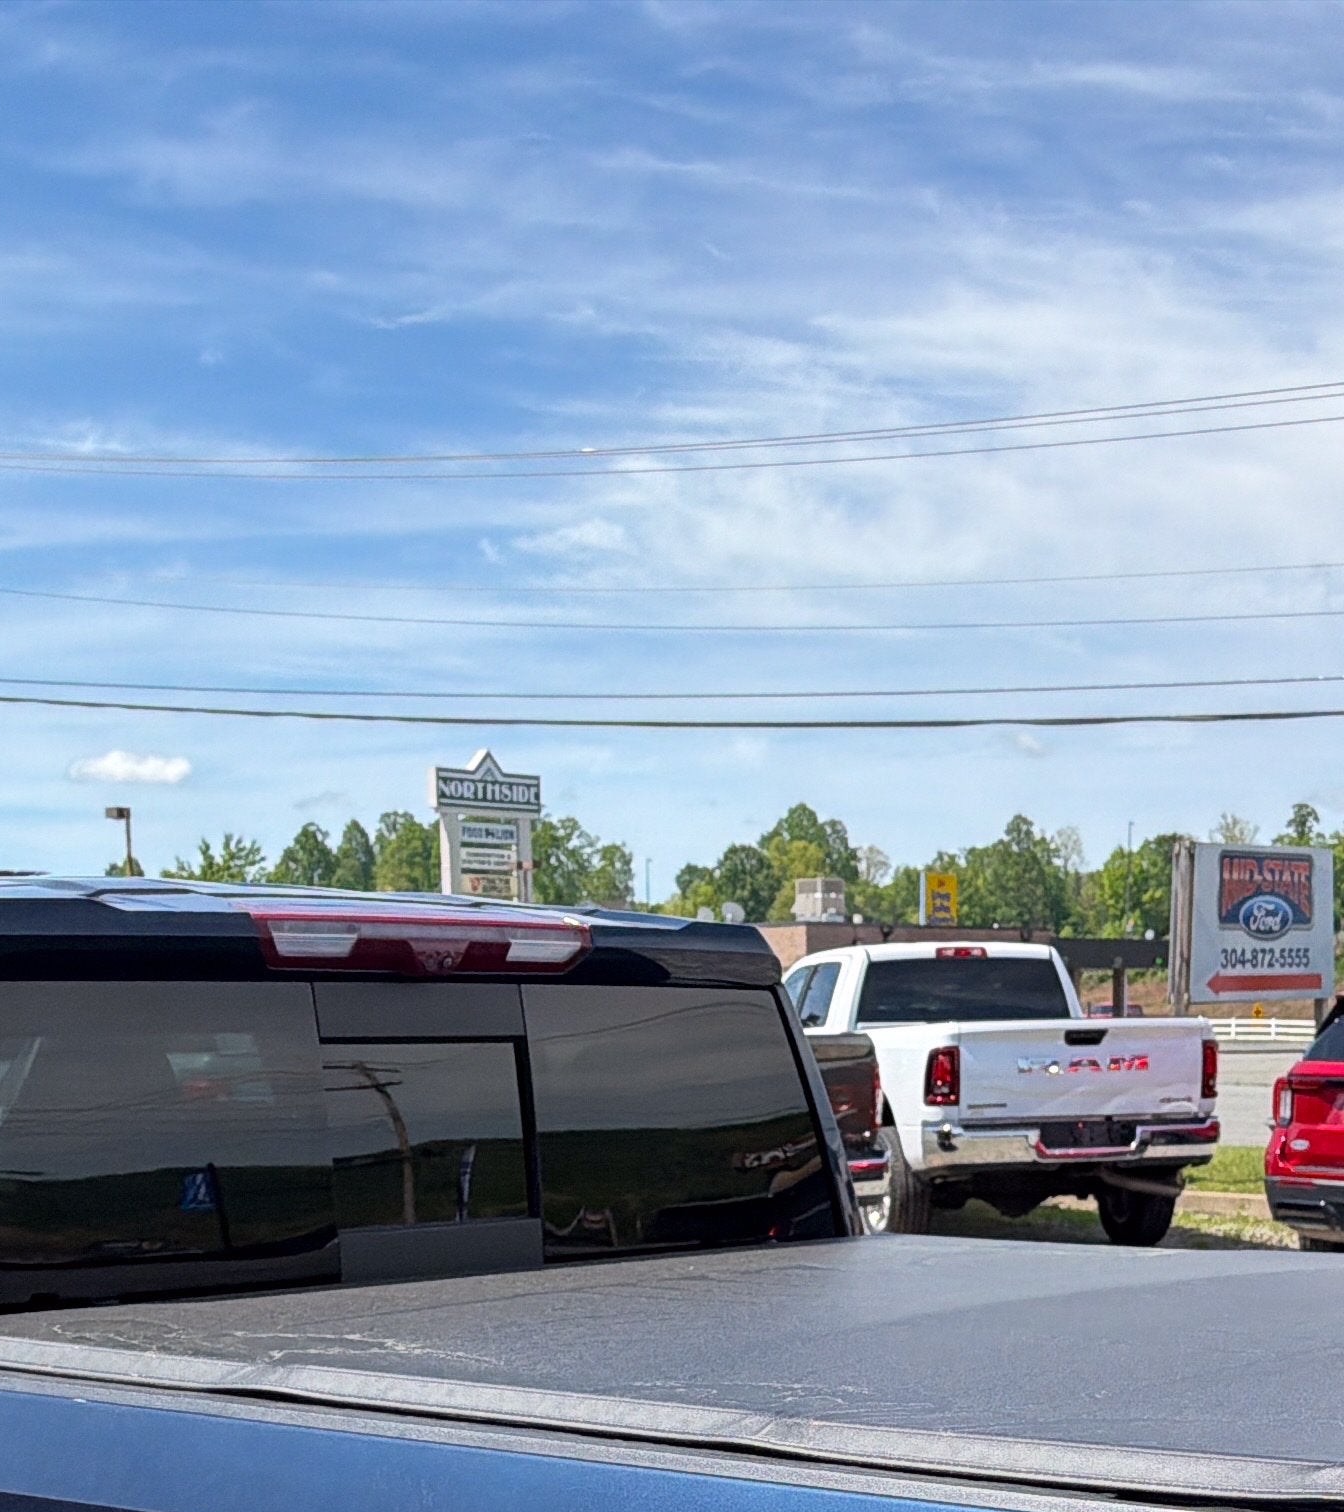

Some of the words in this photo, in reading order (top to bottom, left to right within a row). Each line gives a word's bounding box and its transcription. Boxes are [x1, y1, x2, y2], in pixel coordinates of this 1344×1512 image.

[438, 779, 538, 802] NORTHSIDE
[1249, 902, 1283, 932] Ford
[1220, 948, 1310, 969] 304-872-5555
[1017, 1054, 1150, 1074] RAM
